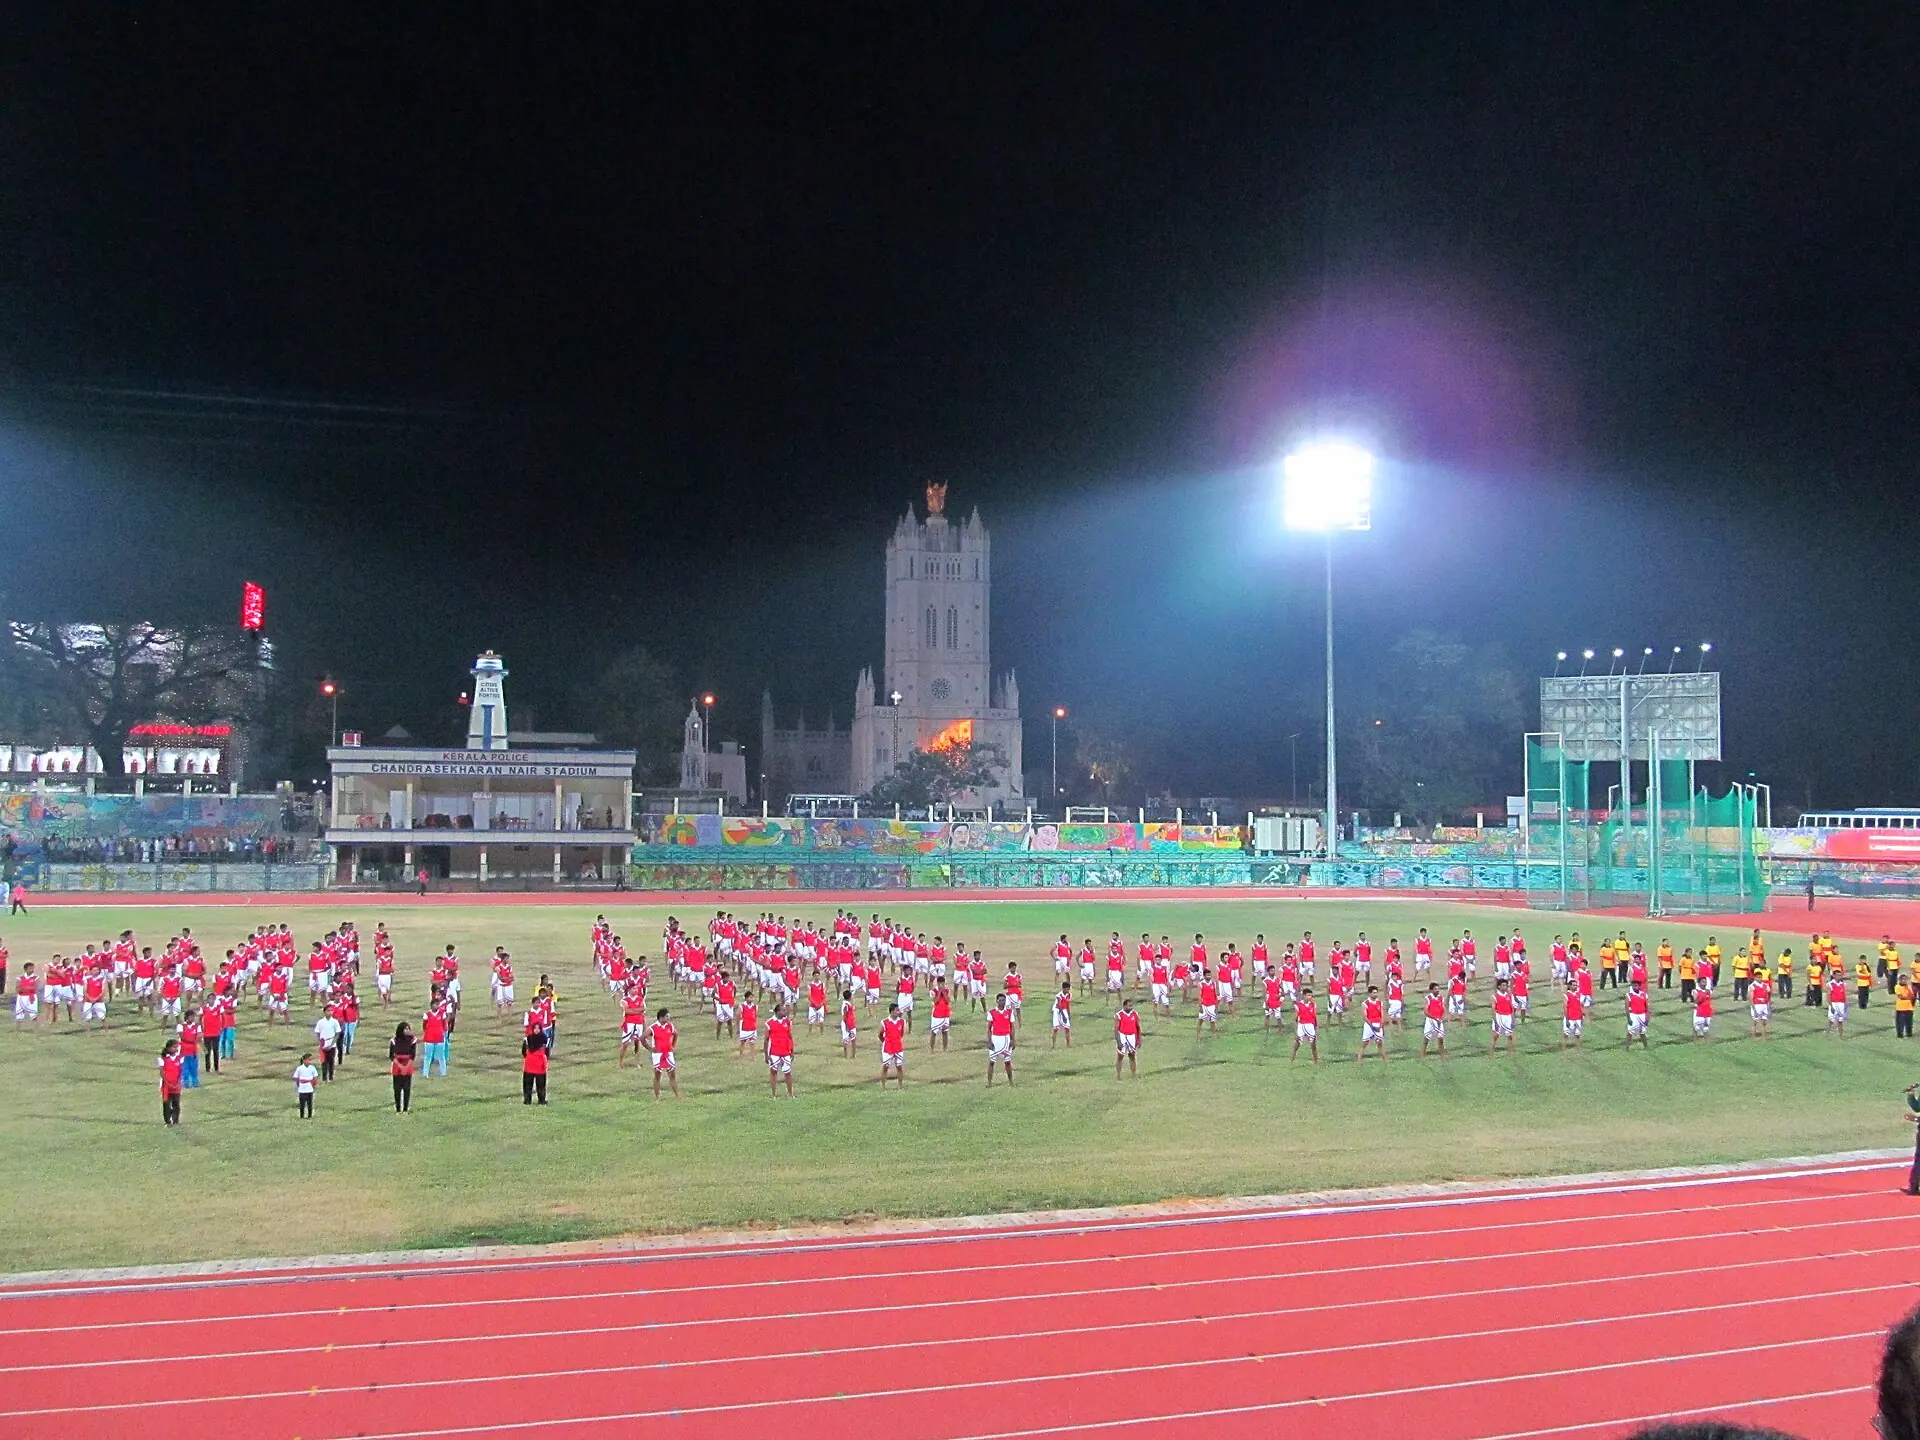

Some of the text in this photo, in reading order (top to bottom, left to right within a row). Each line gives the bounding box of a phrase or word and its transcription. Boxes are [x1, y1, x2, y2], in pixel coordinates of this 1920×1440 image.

[443, 752, 529, 762] KERALA POLICE
[371, 763, 597, 776] CHANDRASEKHARAN NAIR STADIUM
